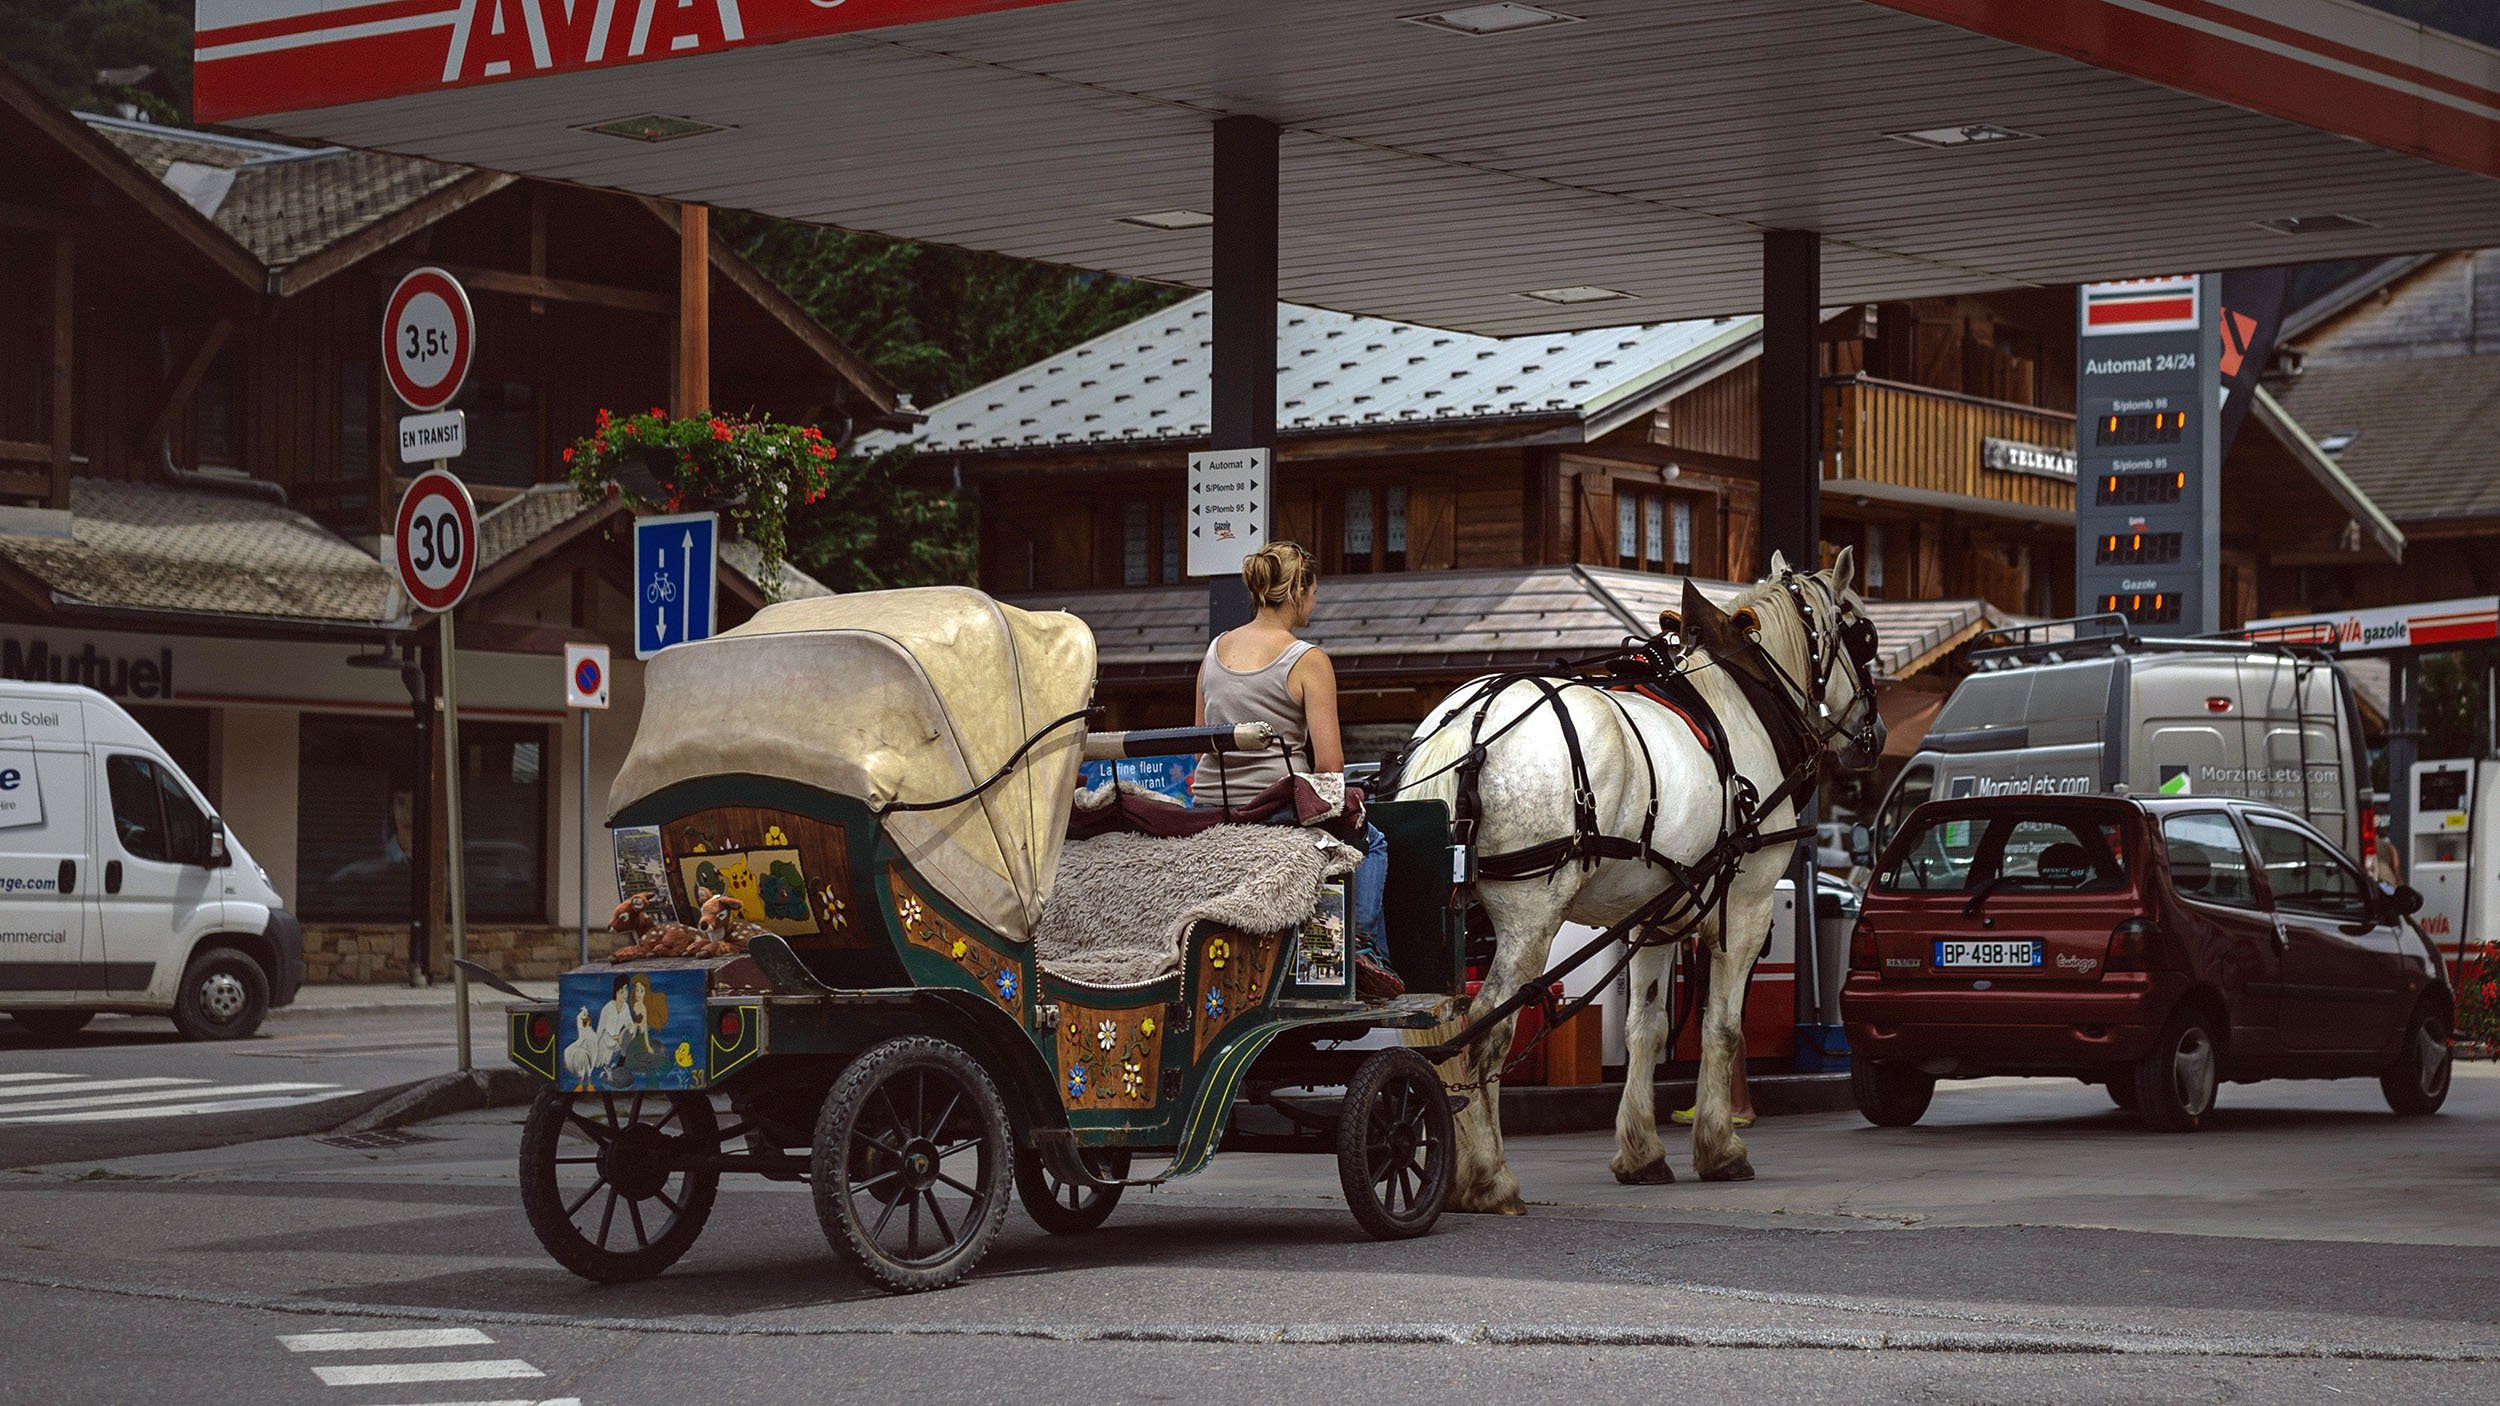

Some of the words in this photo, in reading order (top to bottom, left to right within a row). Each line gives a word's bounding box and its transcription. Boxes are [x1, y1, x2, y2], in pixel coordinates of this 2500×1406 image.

[405, 324, 449, 362] 3,5t
[2086, 357, 2152, 375] Automat
[2156, 353, 2196, 371] 24/24
[2155, 398, 2168, 409] 98
[403, 431, 415, 447] EN
[417, 424, 459, 446] TRANSIT
[1209, 460, 1243, 470] Automat
[2155, 458, 2167, 469] 95
[1205, 483, 1234, 493] S/Plomb
[1236, 482, 1245, 491] 98
[1205, 504, 1235, 514] S/Plomb
[1236, 503, 1244, 513] 95
[413, 512, 460, 572] 30
[2122, 579, 2157, 590] Gazole
[2364, 621, 2406, 645] gazole
[3, 638, 172, 699] Mutuel
[0, 711, 17, 725] du
[21, 711, 59, 726] Soleil
[1100, 764, 1113, 777] La
[1116, 762, 1136, 775] fine
[1140, 760, 1163, 774] fleur
[2056, 953, 2097, 973] twingo
